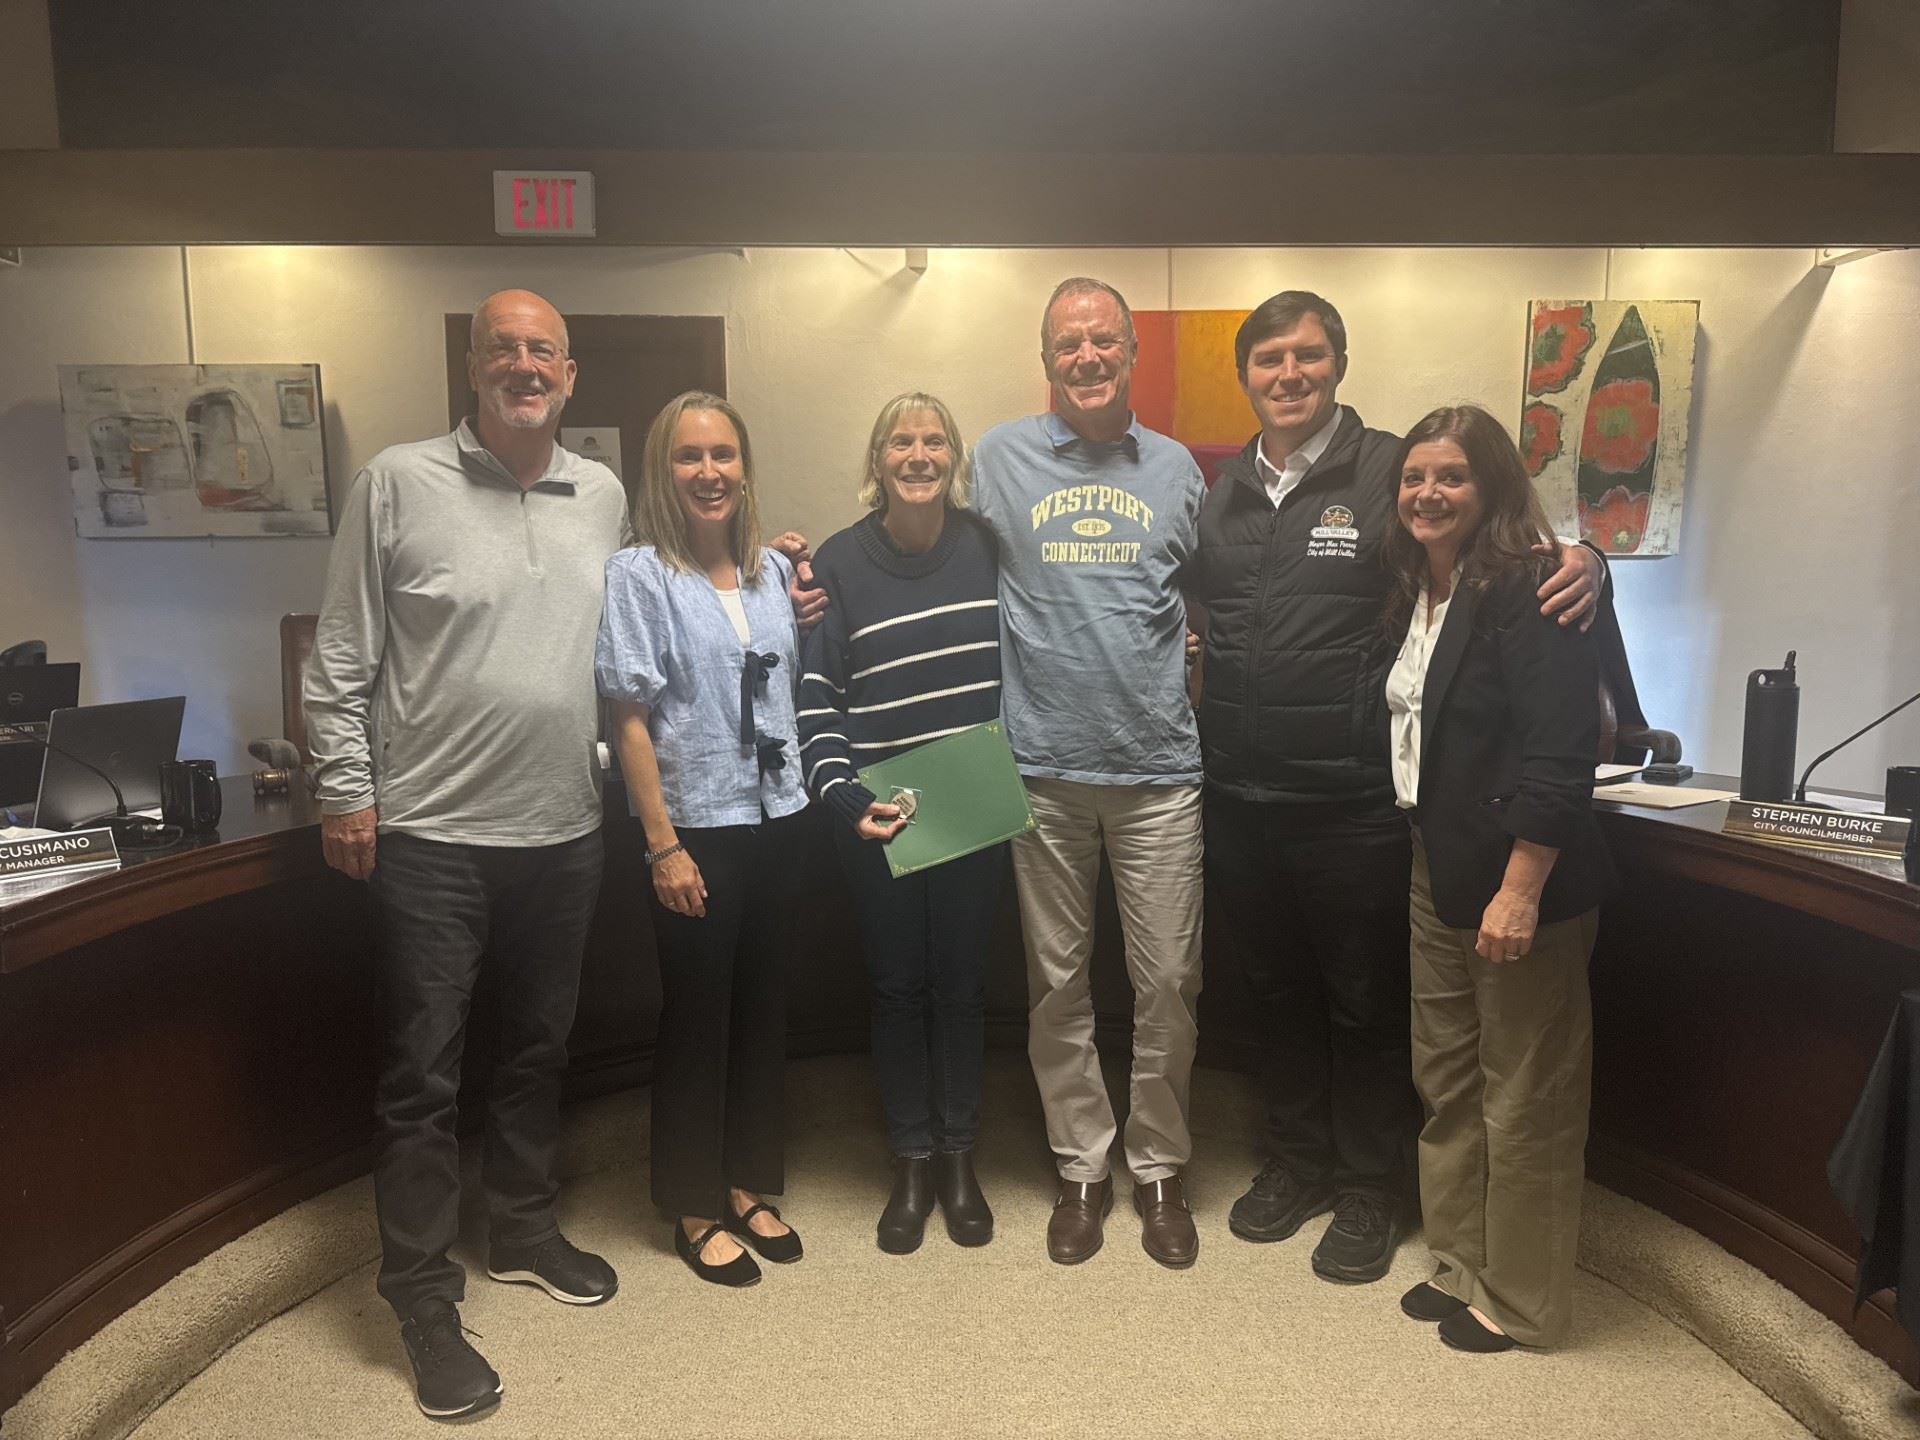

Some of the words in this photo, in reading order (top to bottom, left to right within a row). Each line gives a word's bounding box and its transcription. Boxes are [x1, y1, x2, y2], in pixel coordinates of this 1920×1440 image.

[512, 178, 576, 229] EXIT
[1031, 484, 1154, 532] WESTPORT
[1042, 542, 1141, 563] CONNECTICUT
[1751, 807, 1823, 826] STEPHEN
[1826, 817, 1883, 833] BURKE
[1754, 821, 1777, 831] CITY
[1779, 825, 1874, 844] COUNCILMEMBER
[0, 837, 90, 859] CUSIMANO
[6, 855, 66, 870] MANAGER
